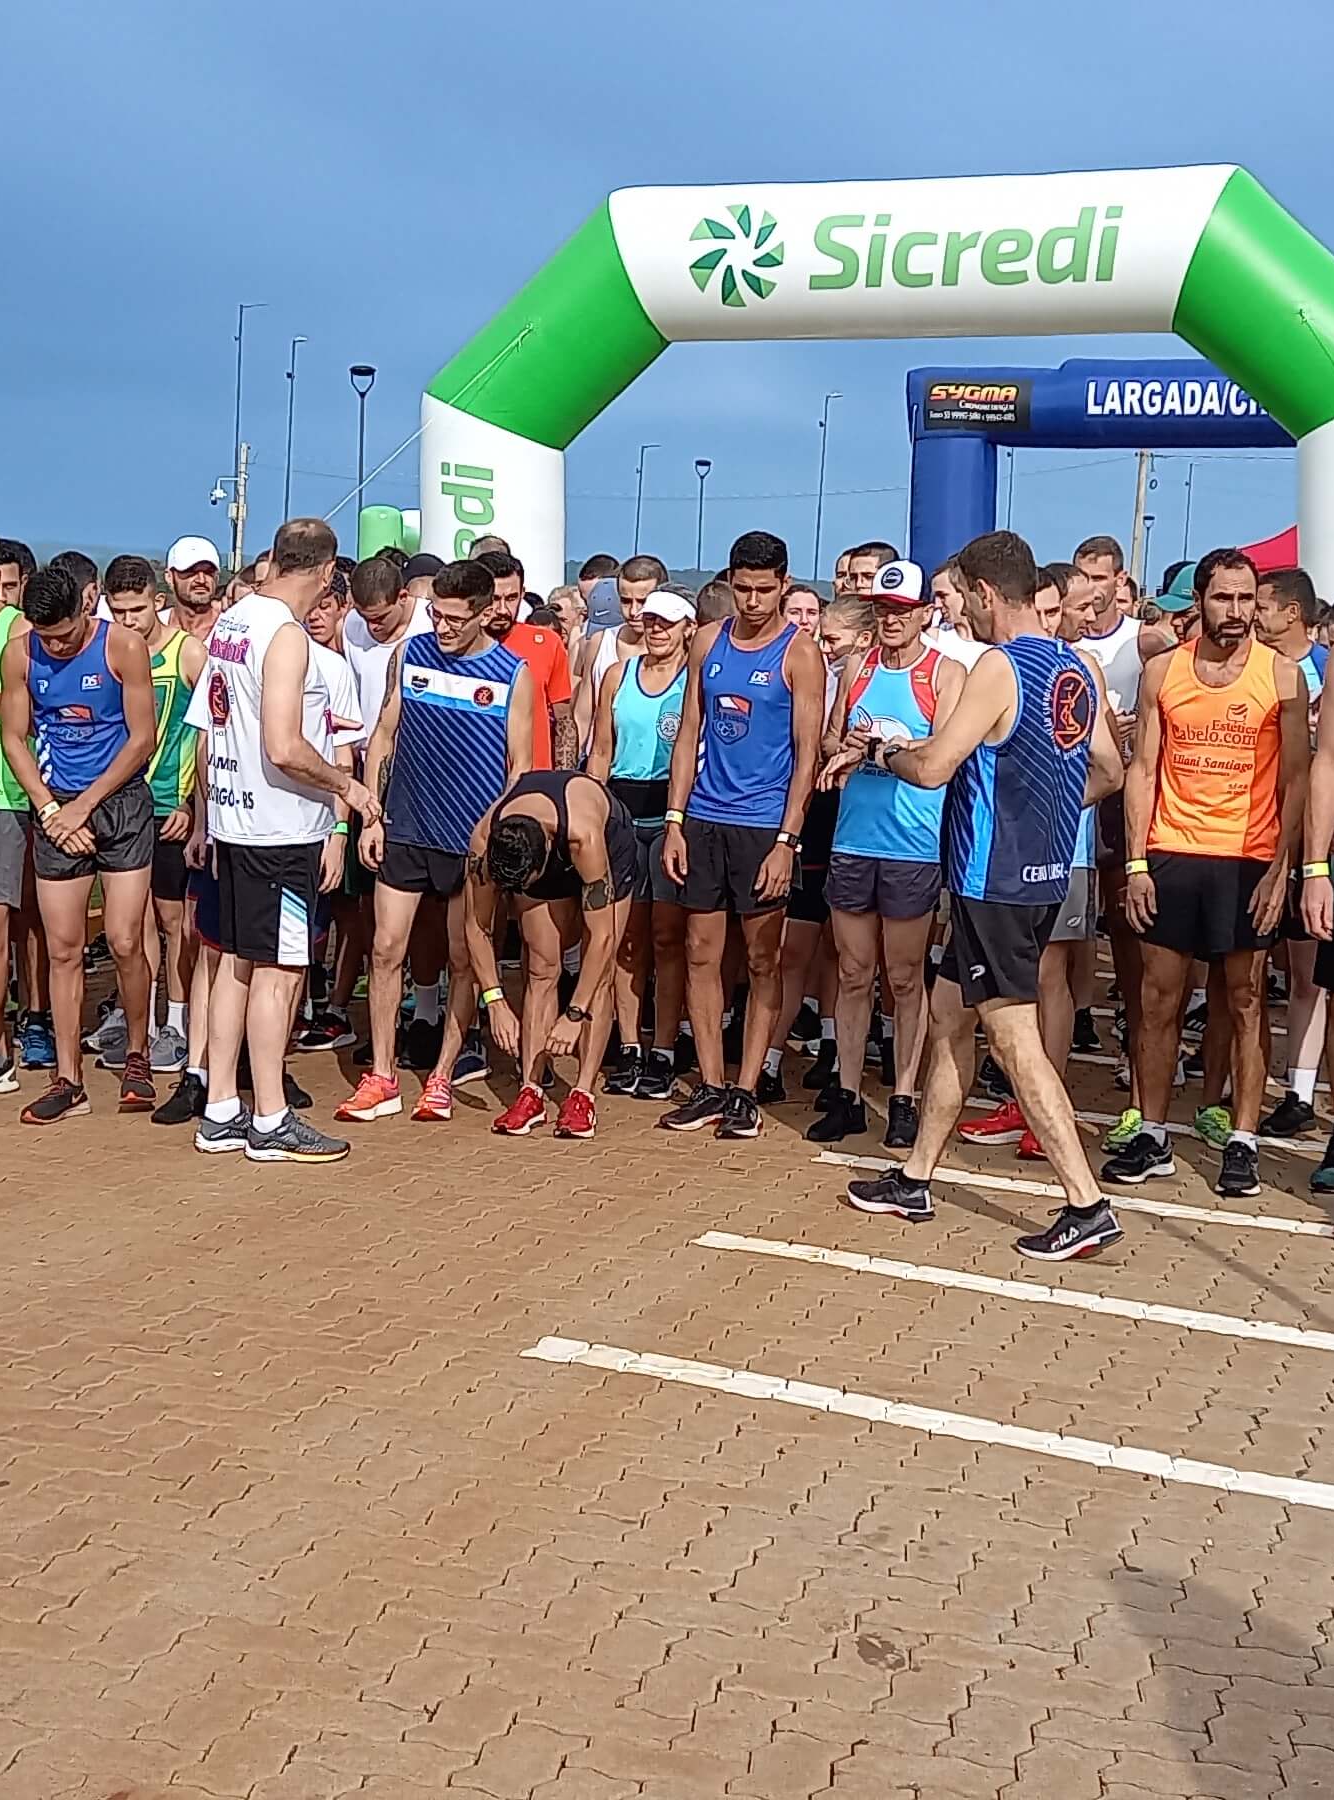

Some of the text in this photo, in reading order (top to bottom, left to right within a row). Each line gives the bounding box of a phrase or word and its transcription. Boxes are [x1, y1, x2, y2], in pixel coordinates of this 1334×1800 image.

[809, 205, 1124, 291] Sicredi
[930, 384, 1018, 402] SYGMA
[1171, 723, 1256, 746] Cabelo.com
[1202, 756, 1254, 774] Santiago
